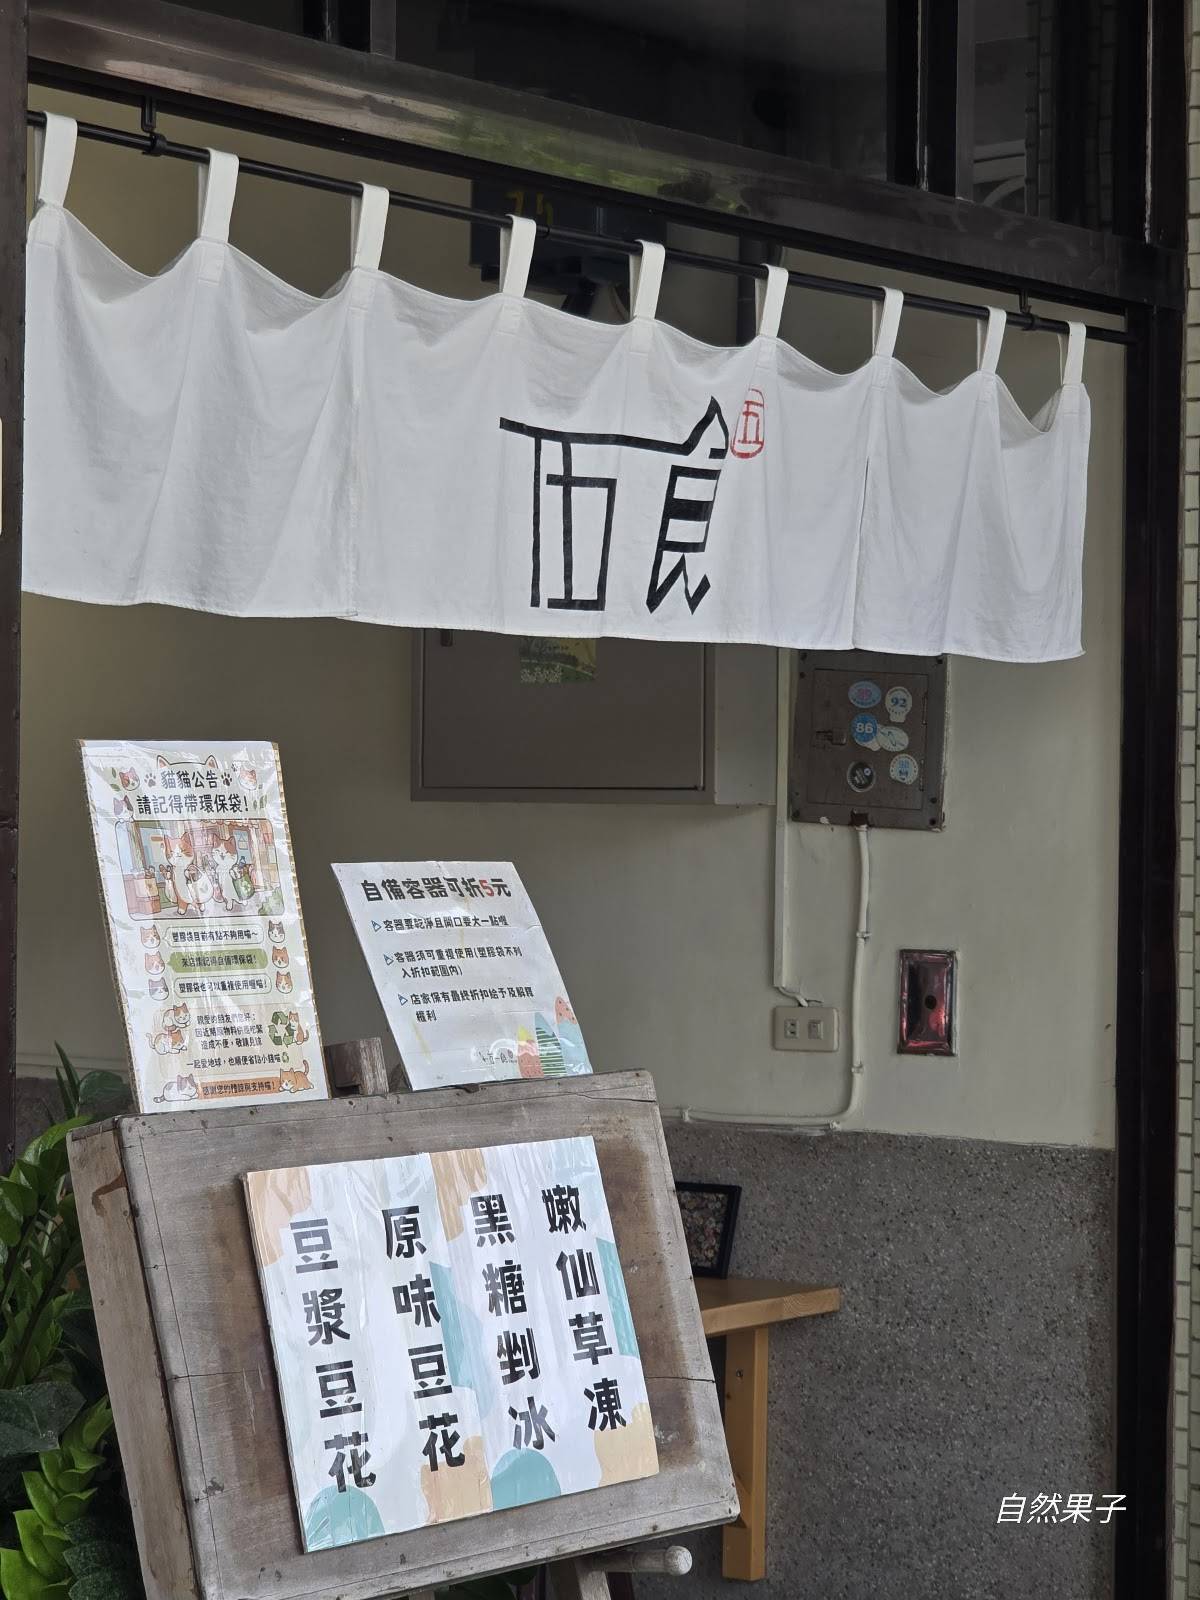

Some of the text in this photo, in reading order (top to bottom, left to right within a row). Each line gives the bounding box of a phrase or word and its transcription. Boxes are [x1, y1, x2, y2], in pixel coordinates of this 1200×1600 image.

[856, 722, 874, 734] 86
[160, 769, 218, 789] 貓貓公告
[361, 877, 512, 902] 自備容器可折5元
[410, 986, 535, 1006] 店家保有最終折扣給予及解釋
[416, 1010, 437, 1022] 權利
[541, 1183, 628, 1432] 嫩仙草凍
[470, 1193, 556, 1450] 黑糖剉冰
[382, 1205, 466, 1473] 原味豆花
[290, 1218, 377, 1494] 豆漿豆花
